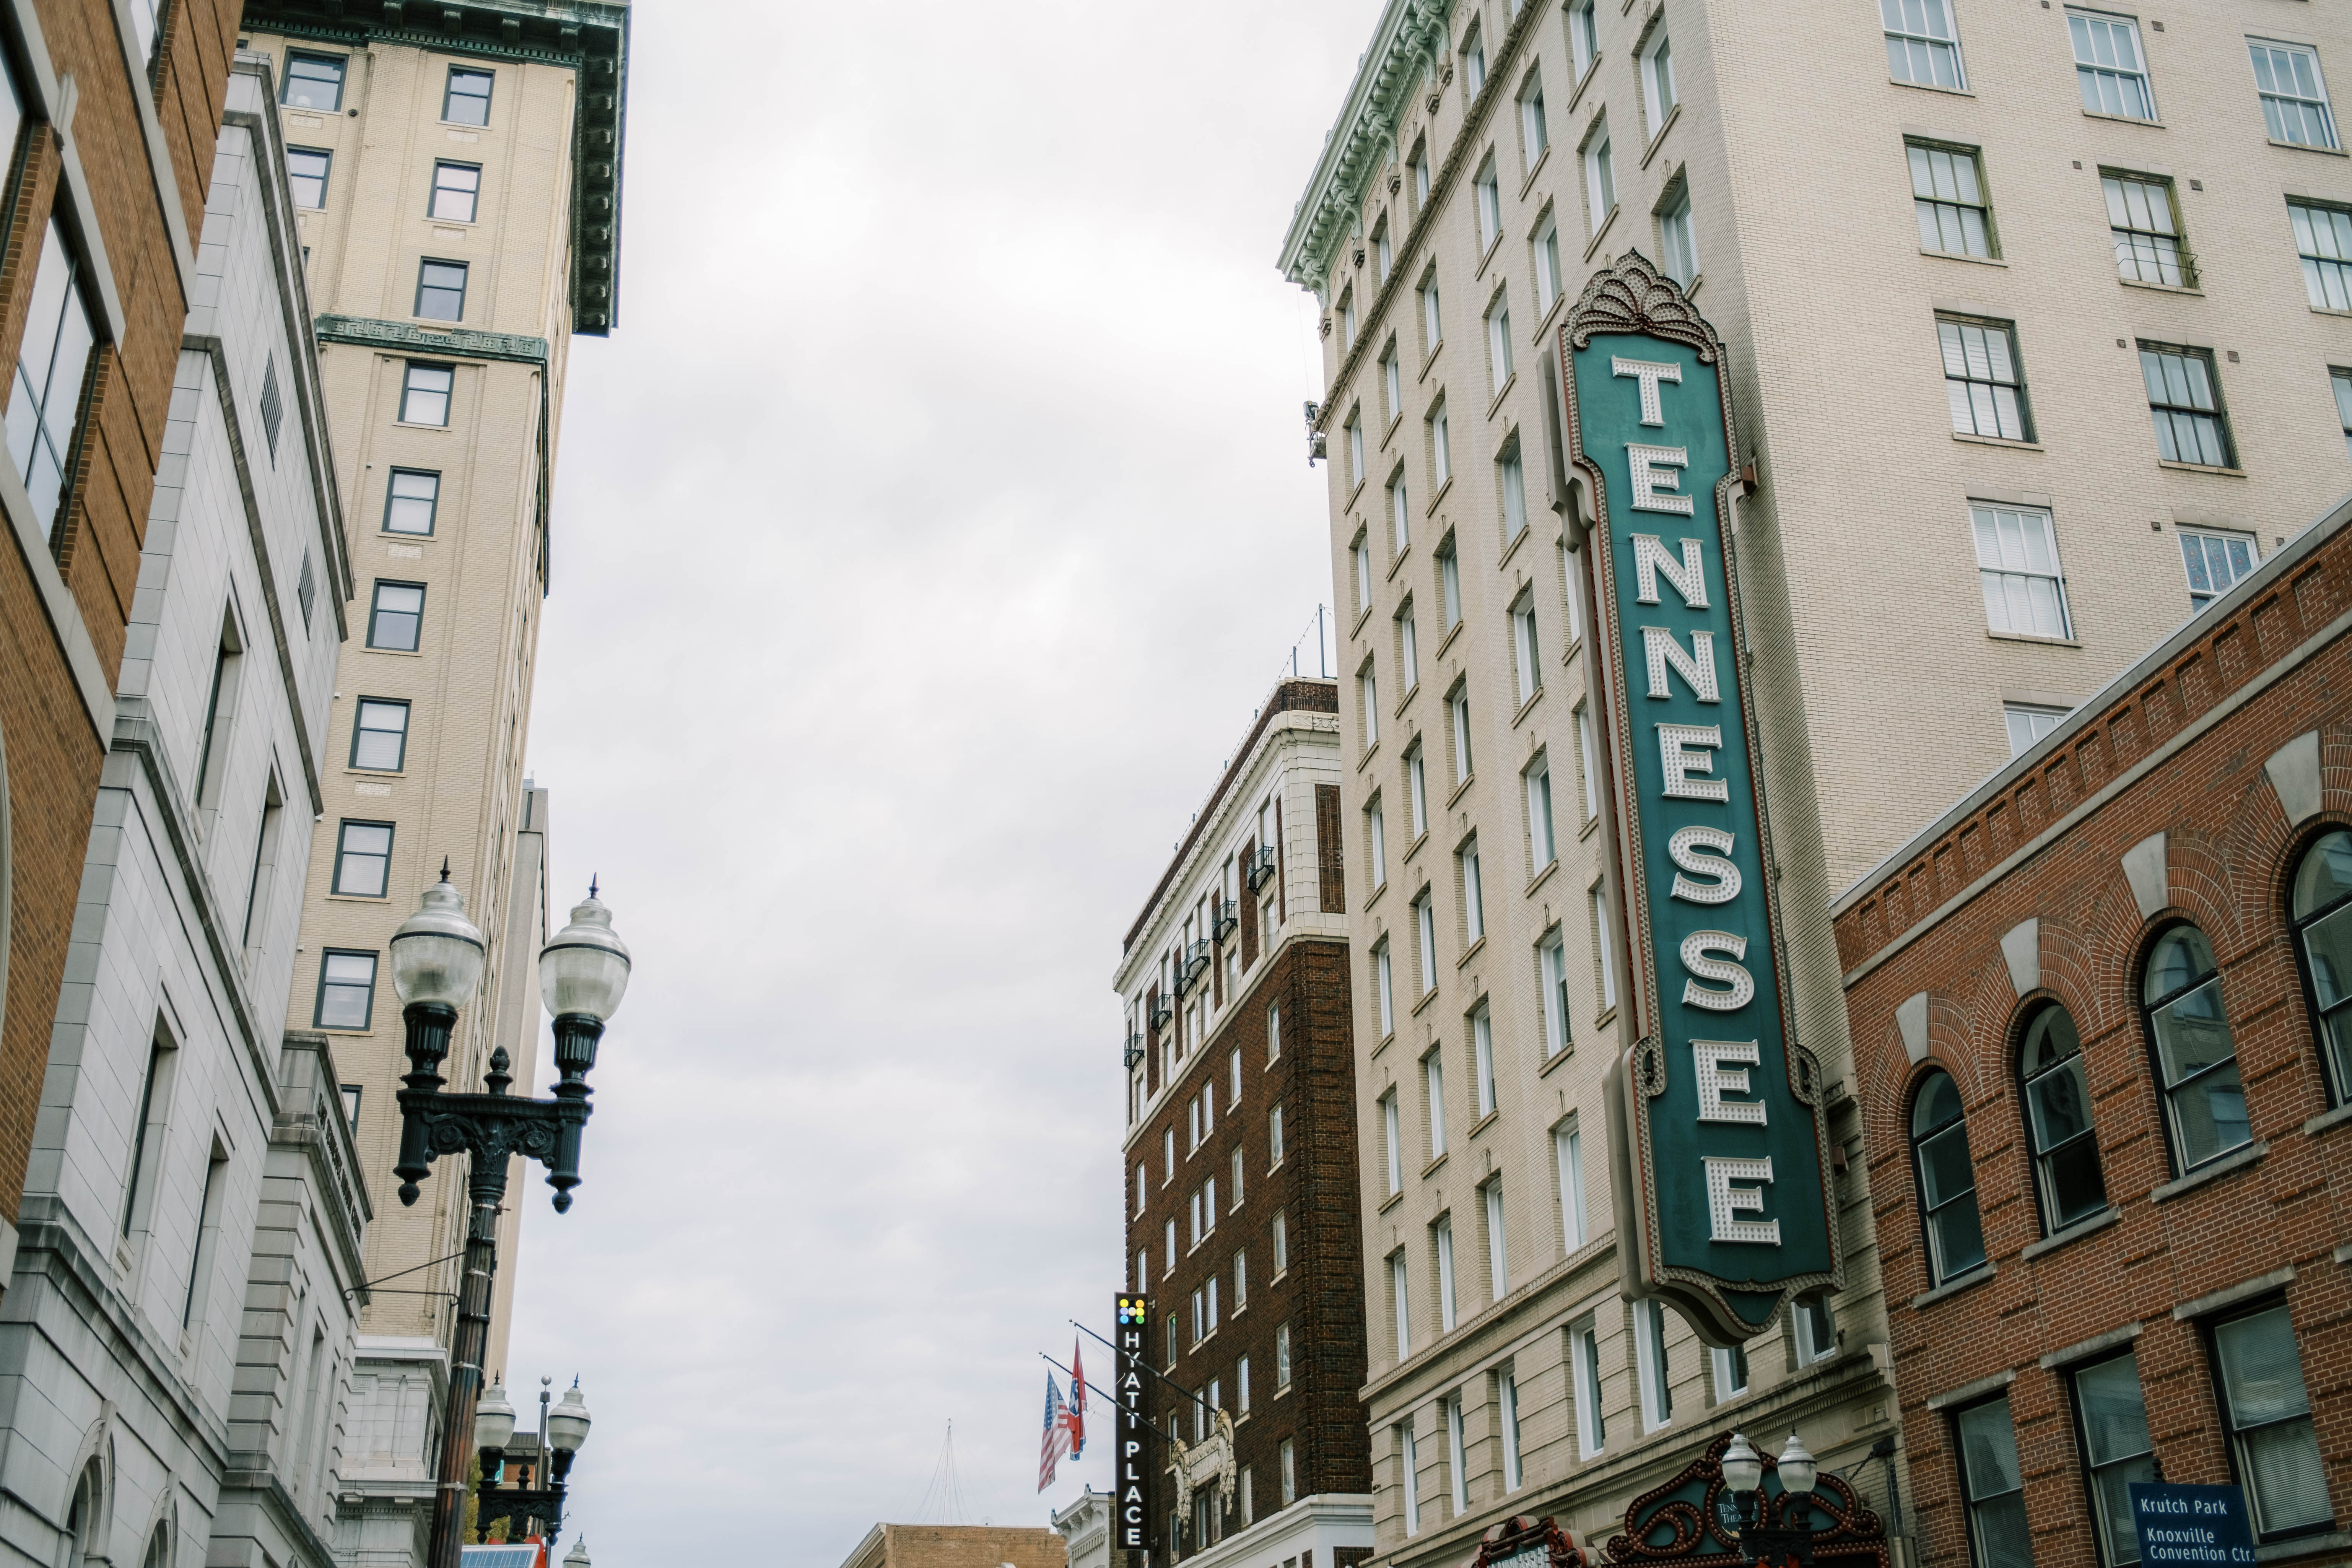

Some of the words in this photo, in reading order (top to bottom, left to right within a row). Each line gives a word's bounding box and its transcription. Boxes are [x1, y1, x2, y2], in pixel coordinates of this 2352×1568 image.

[1611, 355, 1781, 1246] TENNESSEE
[1124, 1331, 1140, 1429] HYATT
[1125, 1441, 1142, 1545] PLACE
[2141, 1498, 2188, 1513] Krutch
[2195, 1500, 2227, 1514] Park
[1721, 1512, 1756, 1523] THEAE
[2147, 1528, 2214, 1543] Knoxville
[2150, 1545, 2226, 1561] Convention
[2232, 1547, 2255, 1562] Ctr.
